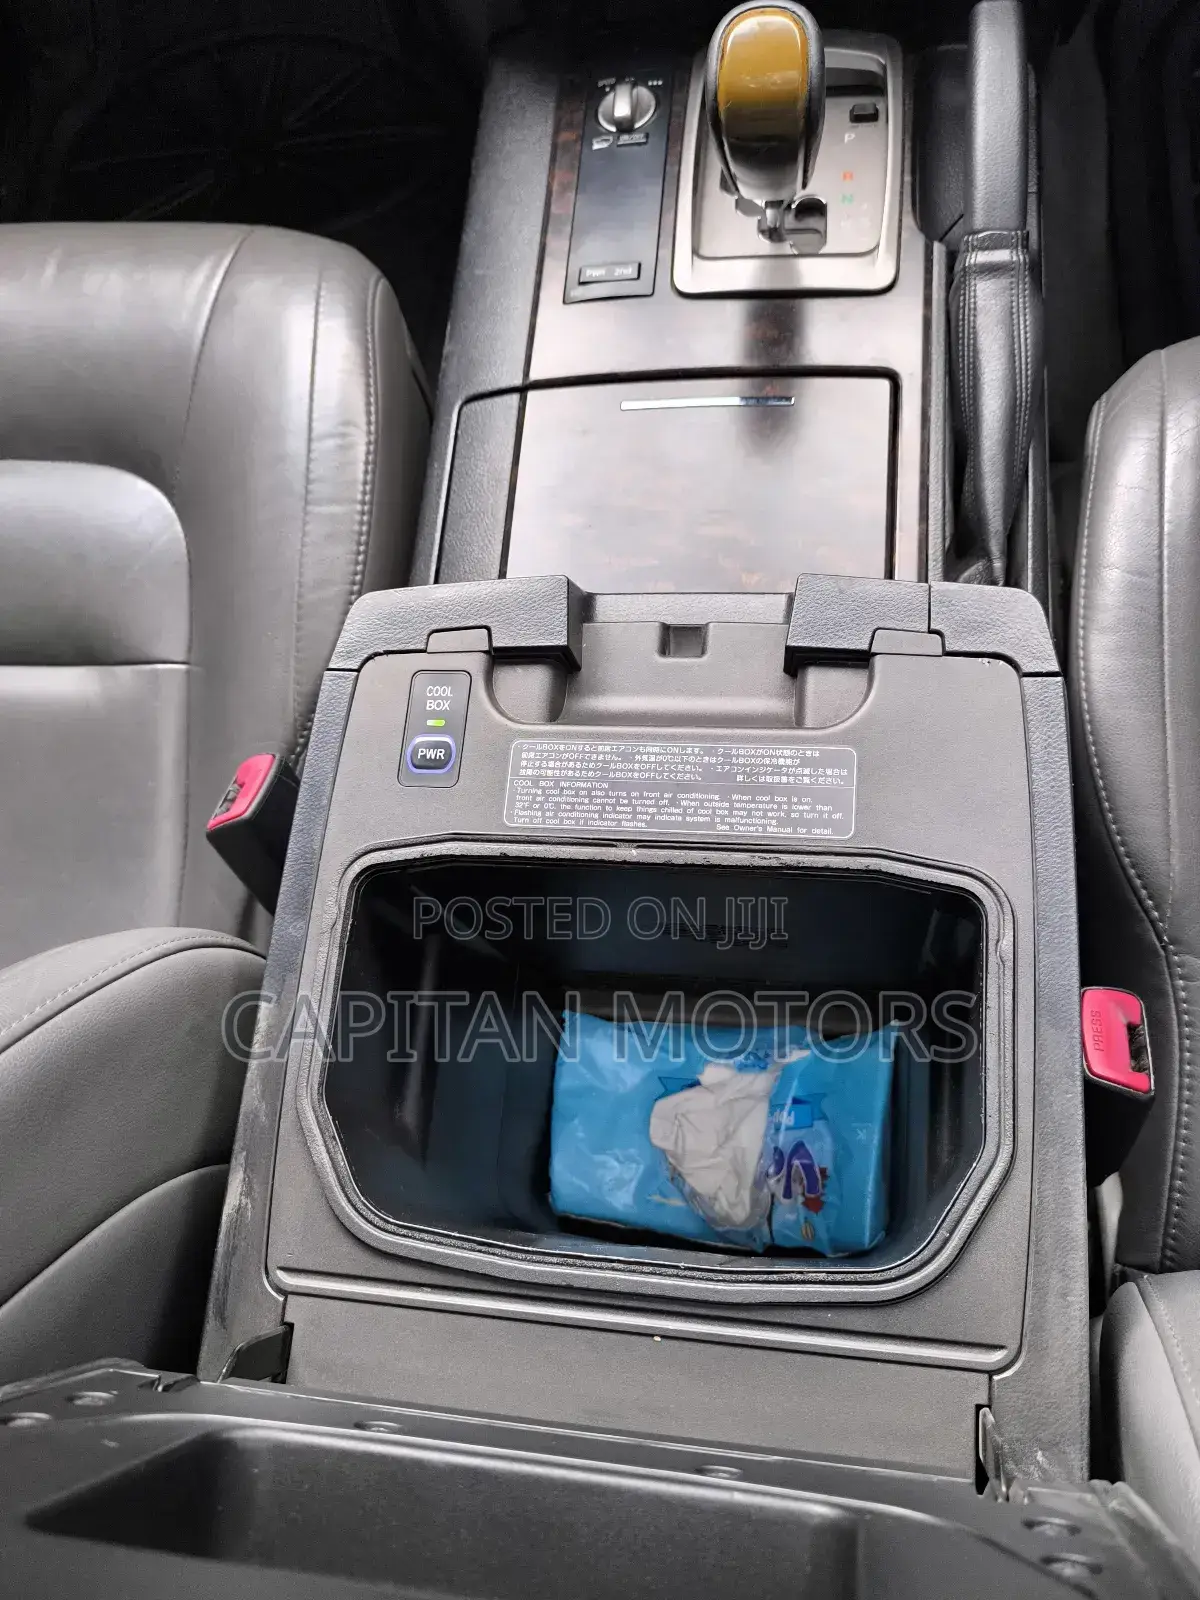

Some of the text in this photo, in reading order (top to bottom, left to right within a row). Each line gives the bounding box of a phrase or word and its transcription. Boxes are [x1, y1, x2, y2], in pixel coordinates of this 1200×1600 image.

[844, 133, 855, 143] P
[426, 686, 453, 697] COOL
[426, 699, 451, 711] BOX
[417, 749, 445, 760] PWR
[575, 803, 602, 811] function
[812, 827, 834, 835] detail.
